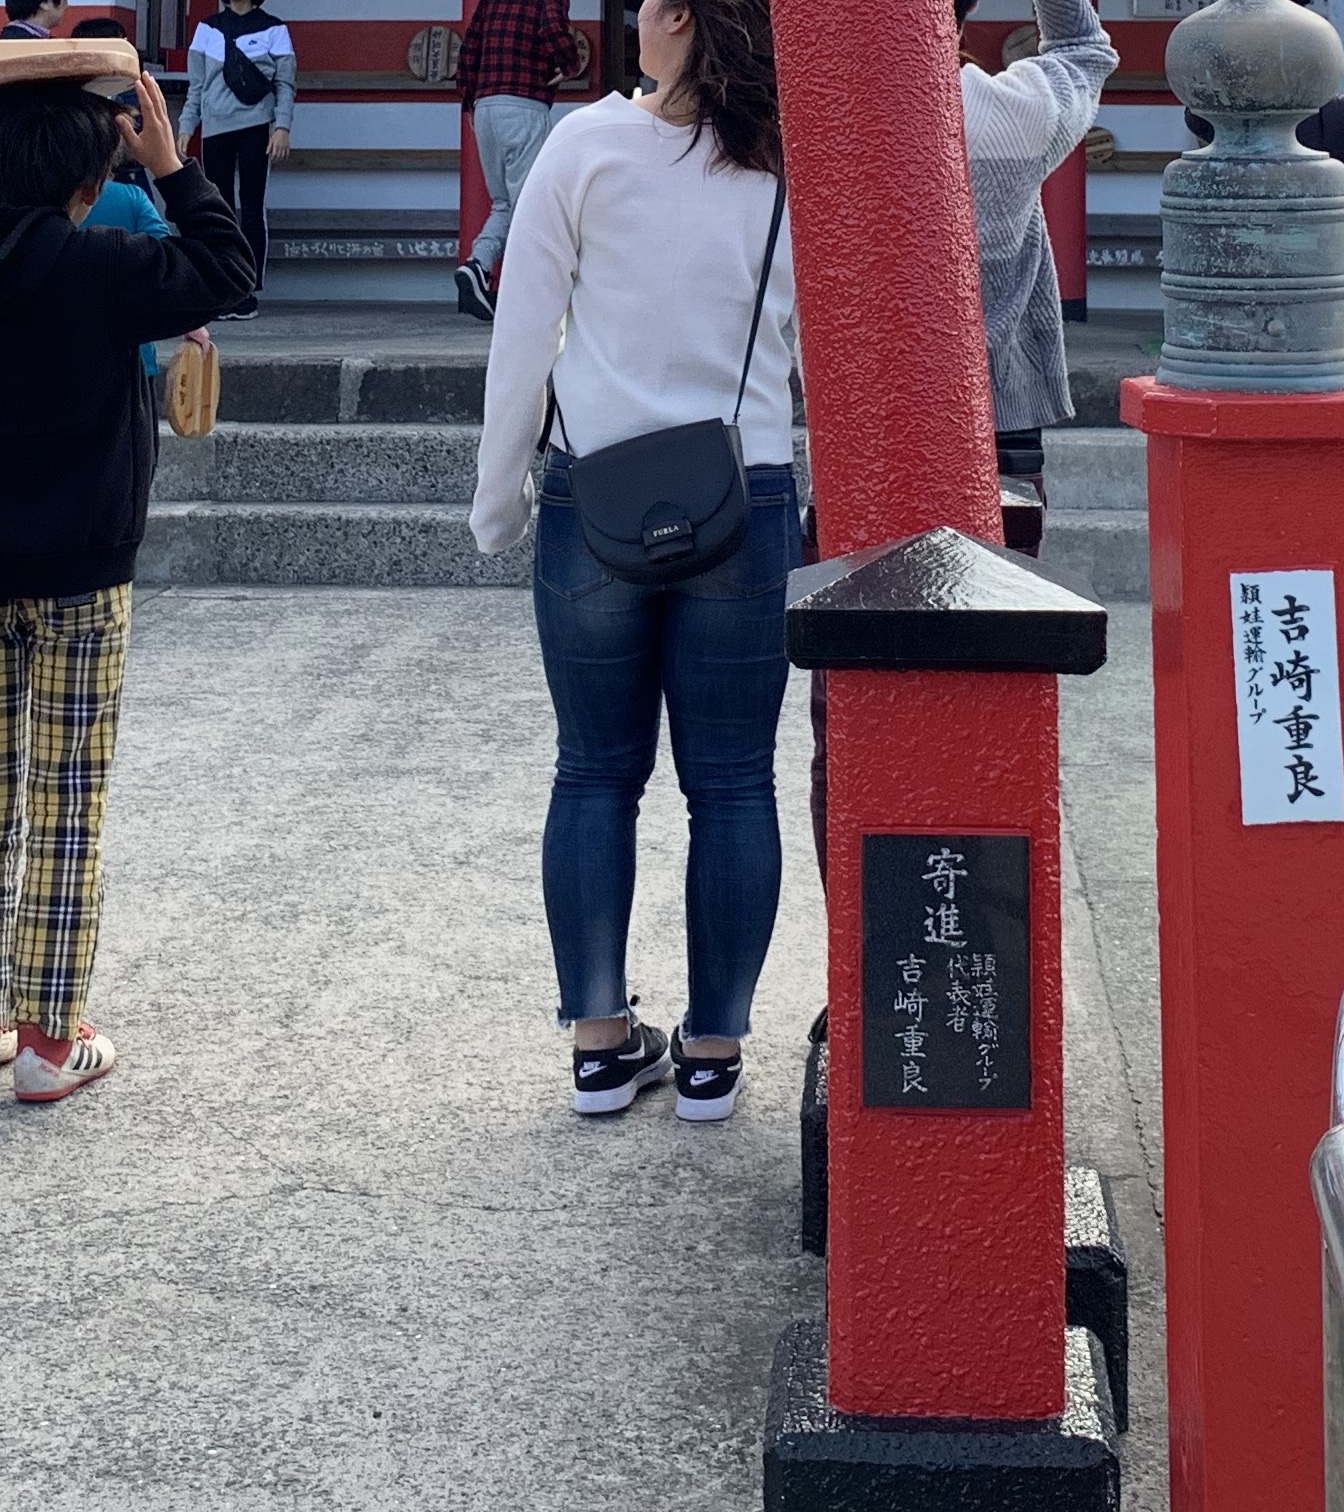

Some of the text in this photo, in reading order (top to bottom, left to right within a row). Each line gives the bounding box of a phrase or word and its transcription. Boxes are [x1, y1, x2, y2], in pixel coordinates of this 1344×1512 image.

[653, 525, 679, 537] FURLA
[1270, 595, 1325, 804] 吉崎重良
[921, 847, 968, 948] 寄進
[894, 953, 929, 1094] 吉崎重良
[946, 954, 972, 1033] 代表者
[583, 1060, 601, 1071] NIKE
[694, 1069, 714, 1079] NIKE
